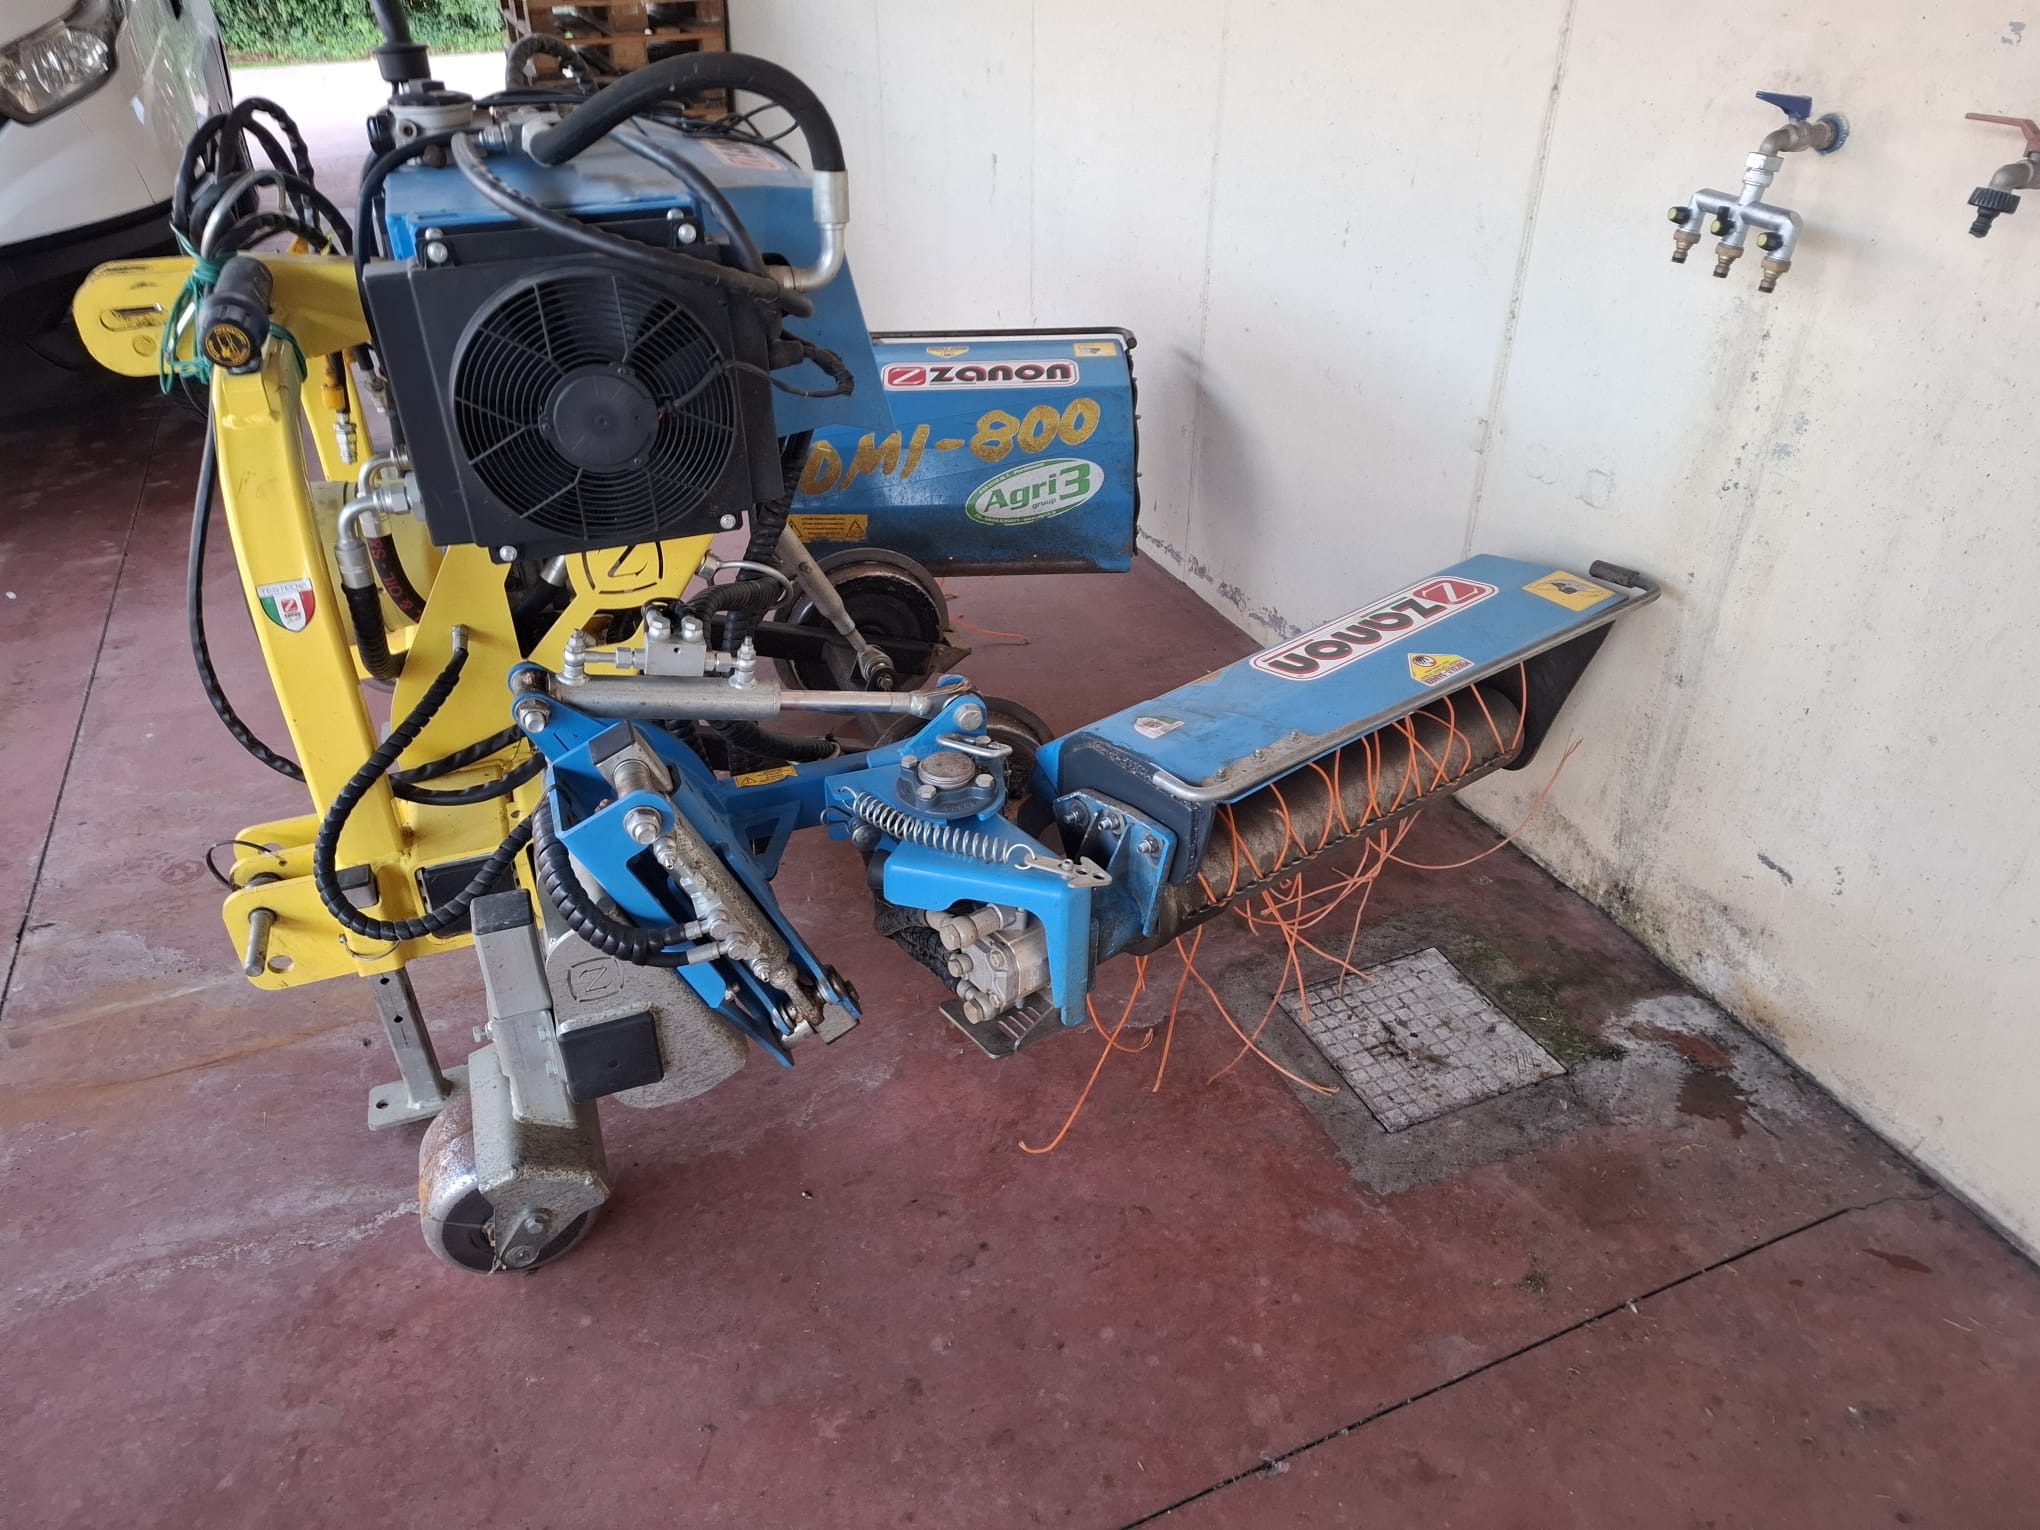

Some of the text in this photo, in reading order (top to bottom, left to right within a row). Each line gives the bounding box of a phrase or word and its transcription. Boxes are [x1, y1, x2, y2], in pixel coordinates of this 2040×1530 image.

[929, 363, 1072, 382] zanon
[799, 397, 1101, 496] DMI-800
[983, 462, 1092, 513] Agri3
[1267, 597, 1448, 675] zanon
